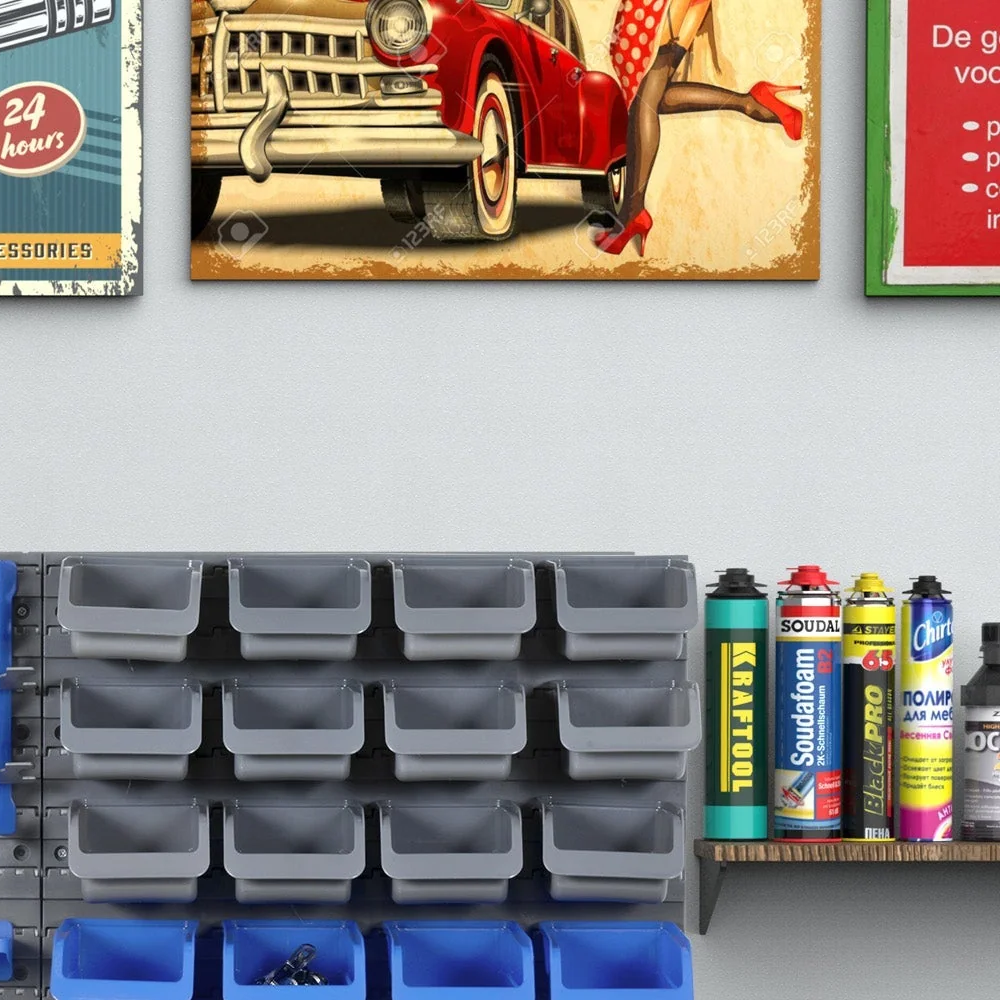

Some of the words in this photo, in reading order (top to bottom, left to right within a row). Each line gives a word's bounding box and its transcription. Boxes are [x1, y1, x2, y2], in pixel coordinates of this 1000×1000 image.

[932, 24, 971, 48] De
[3, 92, 46, 131] 24
[0, 130, 65, 161] hours
[780, 619, 840, 633] SOUDAL
[817, 648, 833, 674] B2
[731, 642, 757, 793] KRAFTOOL
[790, 648, 815, 767] Soudafoam
